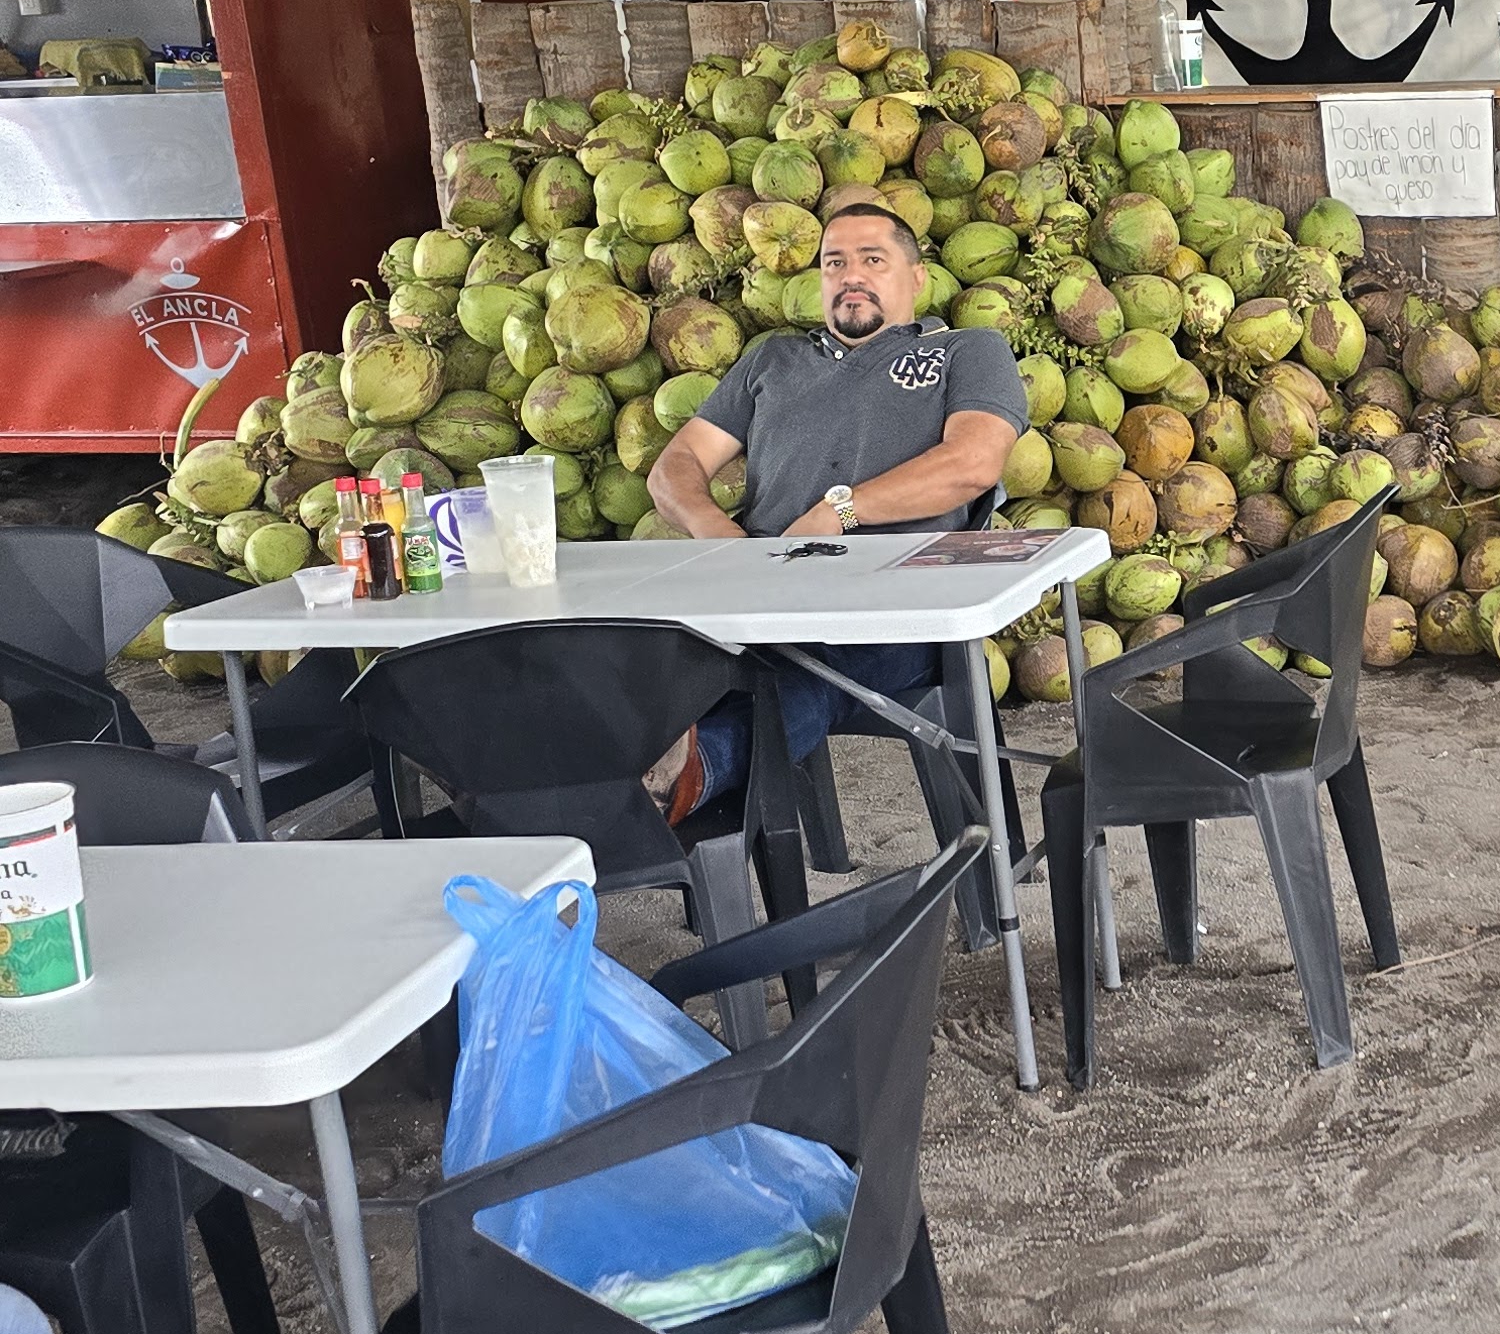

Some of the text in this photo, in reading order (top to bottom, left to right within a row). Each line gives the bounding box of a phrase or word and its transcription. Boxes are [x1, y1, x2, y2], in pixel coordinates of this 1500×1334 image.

[1328, 105, 1481, 152] Postres del día
[1334, 158, 1371, 190] pay
[1371, 154, 1391, 176] de
[1452, 155, 1467, 186] y
[1385, 180, 1434, 211] queso
[131, 297, 239, 327] EL ANCLA
